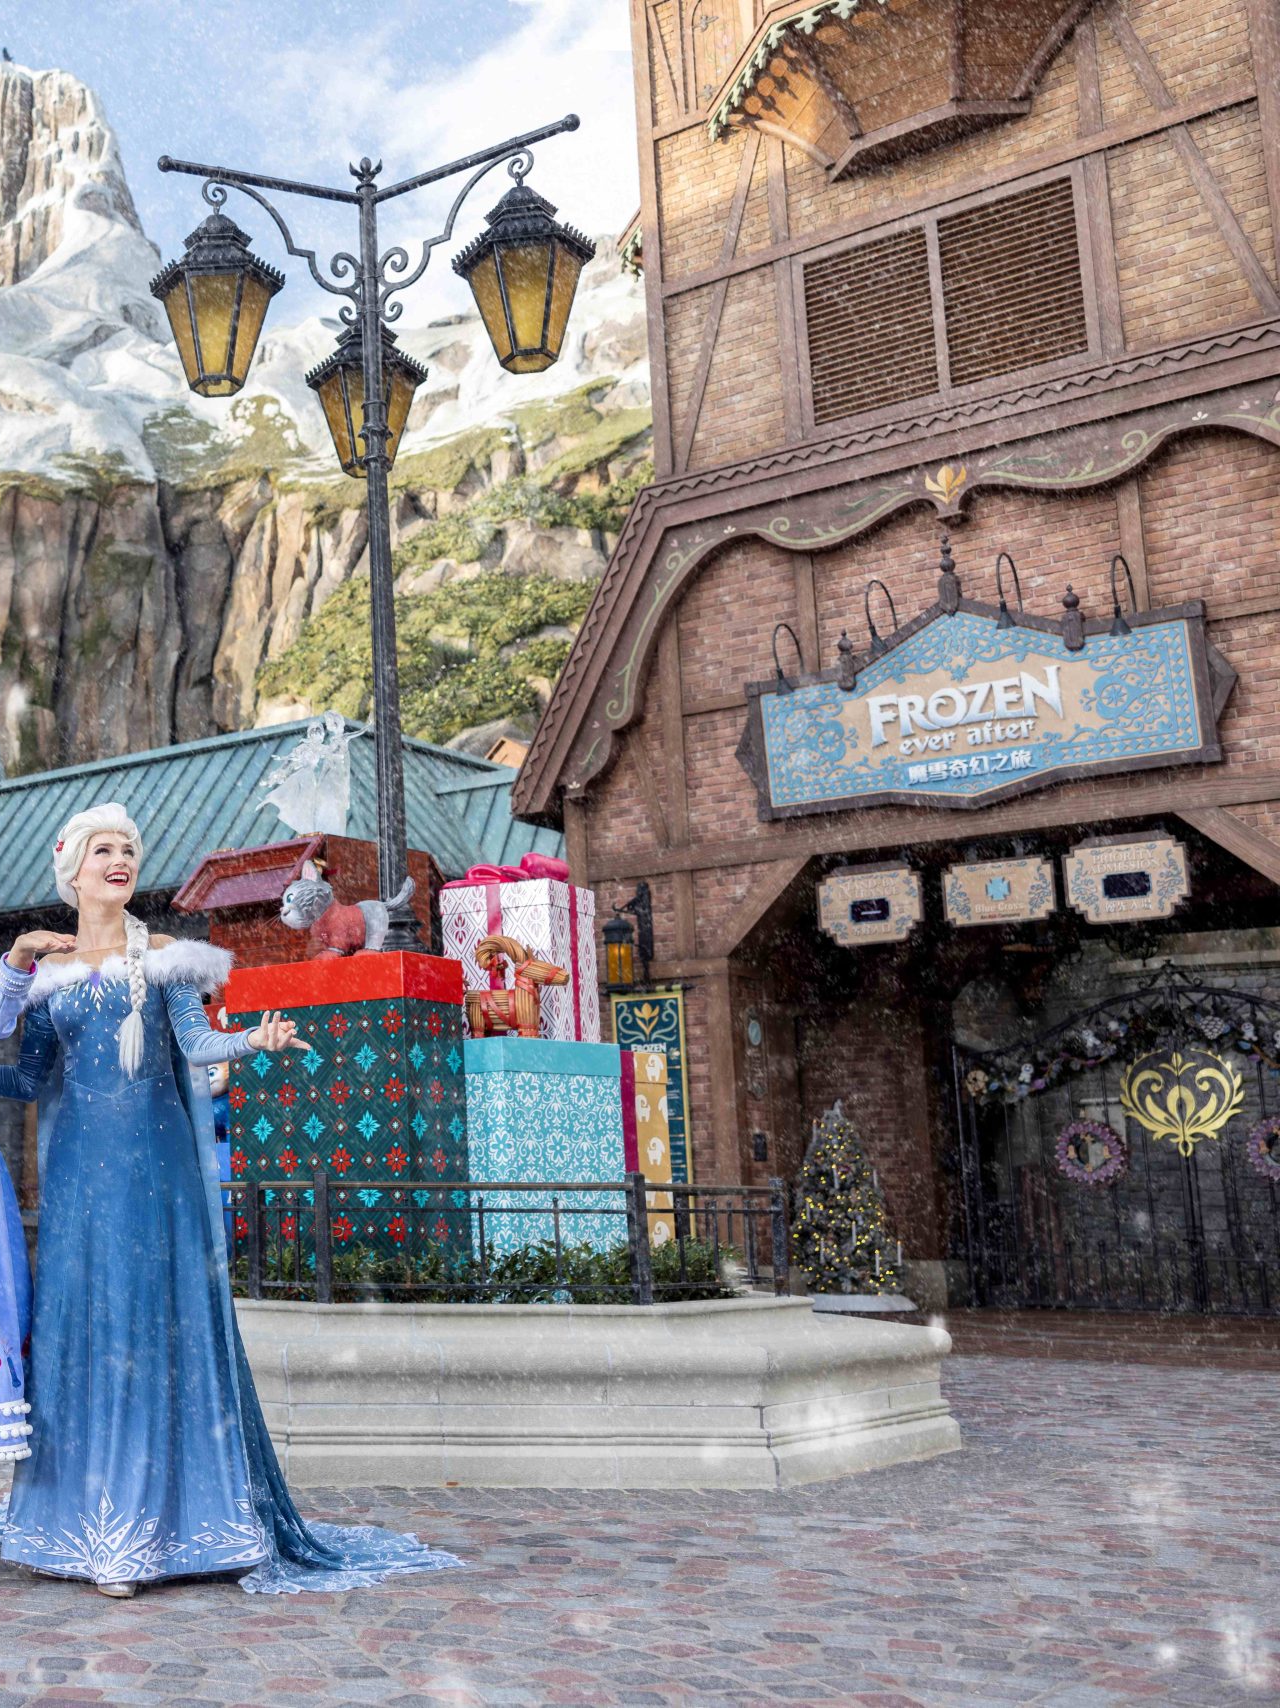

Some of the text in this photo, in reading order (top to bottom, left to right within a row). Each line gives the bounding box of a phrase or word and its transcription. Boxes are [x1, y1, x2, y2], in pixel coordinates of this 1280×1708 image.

[866, 664, 1064, 749] FROZEN
[899, 719, 1036, 755] ever after
[908, 750, 1037, 786] 魔雪奇幻之旅
[1092, 849, 1155, 864] PRIORITY
[1088, 858, 1162, 874] ADMISSION
[975, 903, 994, 913] Blue
[631, 1042, 667, 1053] FROZEN
